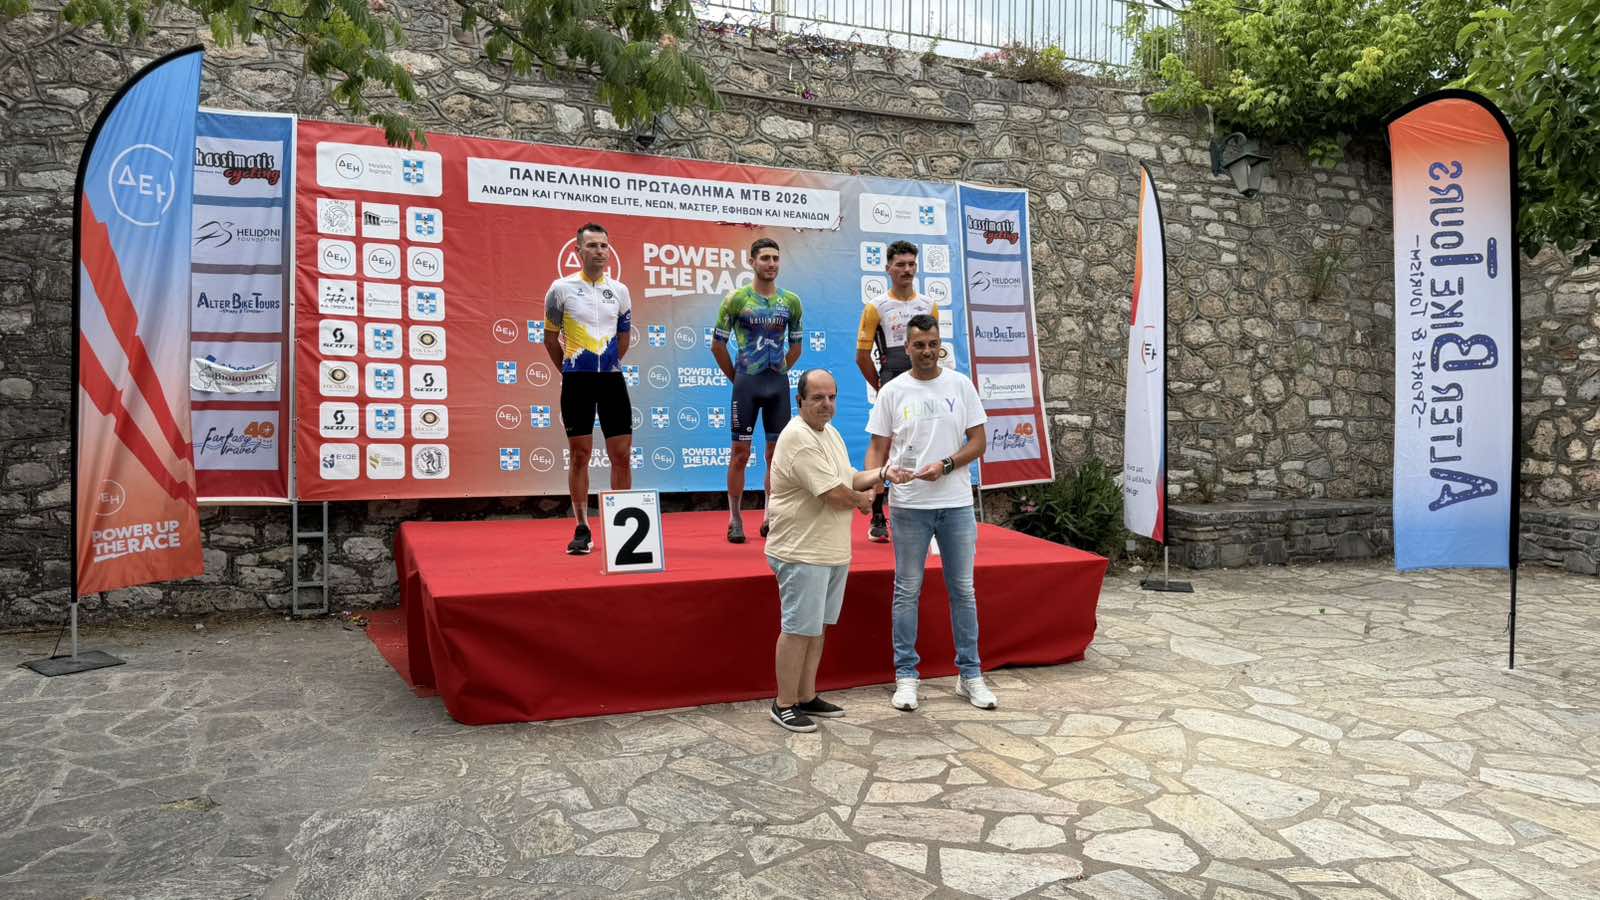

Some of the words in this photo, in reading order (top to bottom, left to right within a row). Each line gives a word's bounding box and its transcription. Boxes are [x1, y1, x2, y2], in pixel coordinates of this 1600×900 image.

[510, 167, 620, 189] ΠΑΝΕΛΛΗΝΙΟ
[627, 178, 735, 200] ΠΡΩΤΑΘΛΗΜΑ
[740, 188, 770, 200] MTB
[776, 192, 808, 204] 2026
[482, 184, 529, 197] ΑΝΔΡΩΝ
[532, 189, 551, 199] ΚΑΙ
[554, 191, 608, 204] ΓΥΝΑΙΚΩΝ
[611, 196, 642, 208] ELITE,
[645, 199, 676, 210] ΝΕΩΝ,
[680, 202, 720, 214] ΜΑΣΤΕΡ,
[722, 206, 762, 216] ΕΦΗΒΩΝ
[765, 208, 780, 217] ΚΑΙ
[784, 210, 830, 221] ΝΕΑΝΙΔΩΝ
[237, 228, 280, 236] HELIDONI
[644, 243, 736, 268] POWER
[644, 266, 693, 286] THE
[696, 271, 754, 294] RAC
[197, 292, 230, 309] ALTER
[232, 293, 254, 309] BIKE
[252, 292, 280, 309] TOURS
[678, 367, 713, 376] POWER
[698, 376, 727, 386] RACE
[244, 421, 274, 438] 40
[682, 448, 718, 457] POWER
[92, 523, 153, 542] POWER
[156, 520, 180, 533] UP
[614, 507, 653, 565] 2
[94, 540, 126, 555] THE
[127, 532, 181, 553] RACE
